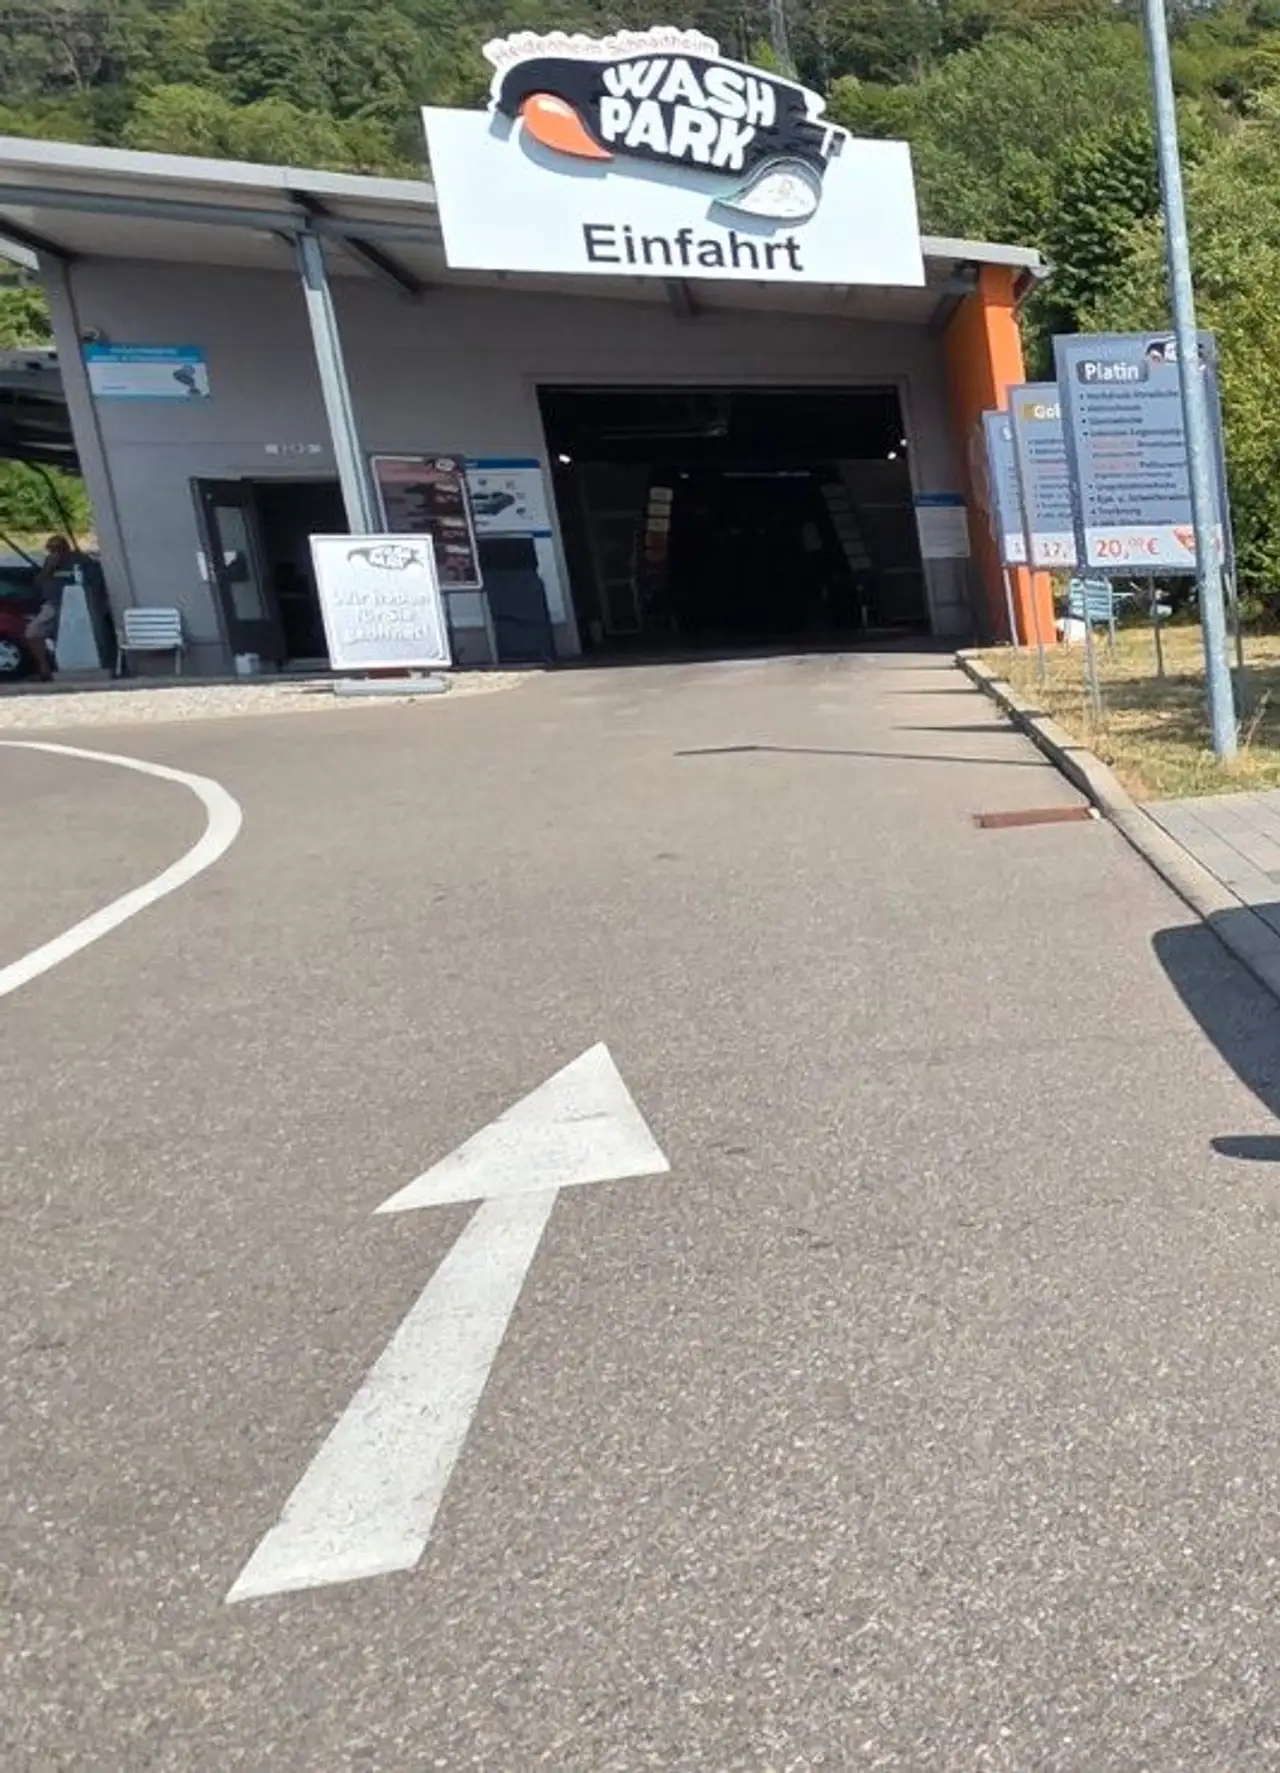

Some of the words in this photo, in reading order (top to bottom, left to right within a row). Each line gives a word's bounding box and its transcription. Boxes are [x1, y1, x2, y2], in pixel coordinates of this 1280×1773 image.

[601, 58, 776, 126] WASH
[600, 96, 755, 170] PARK
[583, 223, 804, 272] Einfahrt
[1083, 362, 1140, 380] Platin
[1033, 403, 1060, 419] Gol
